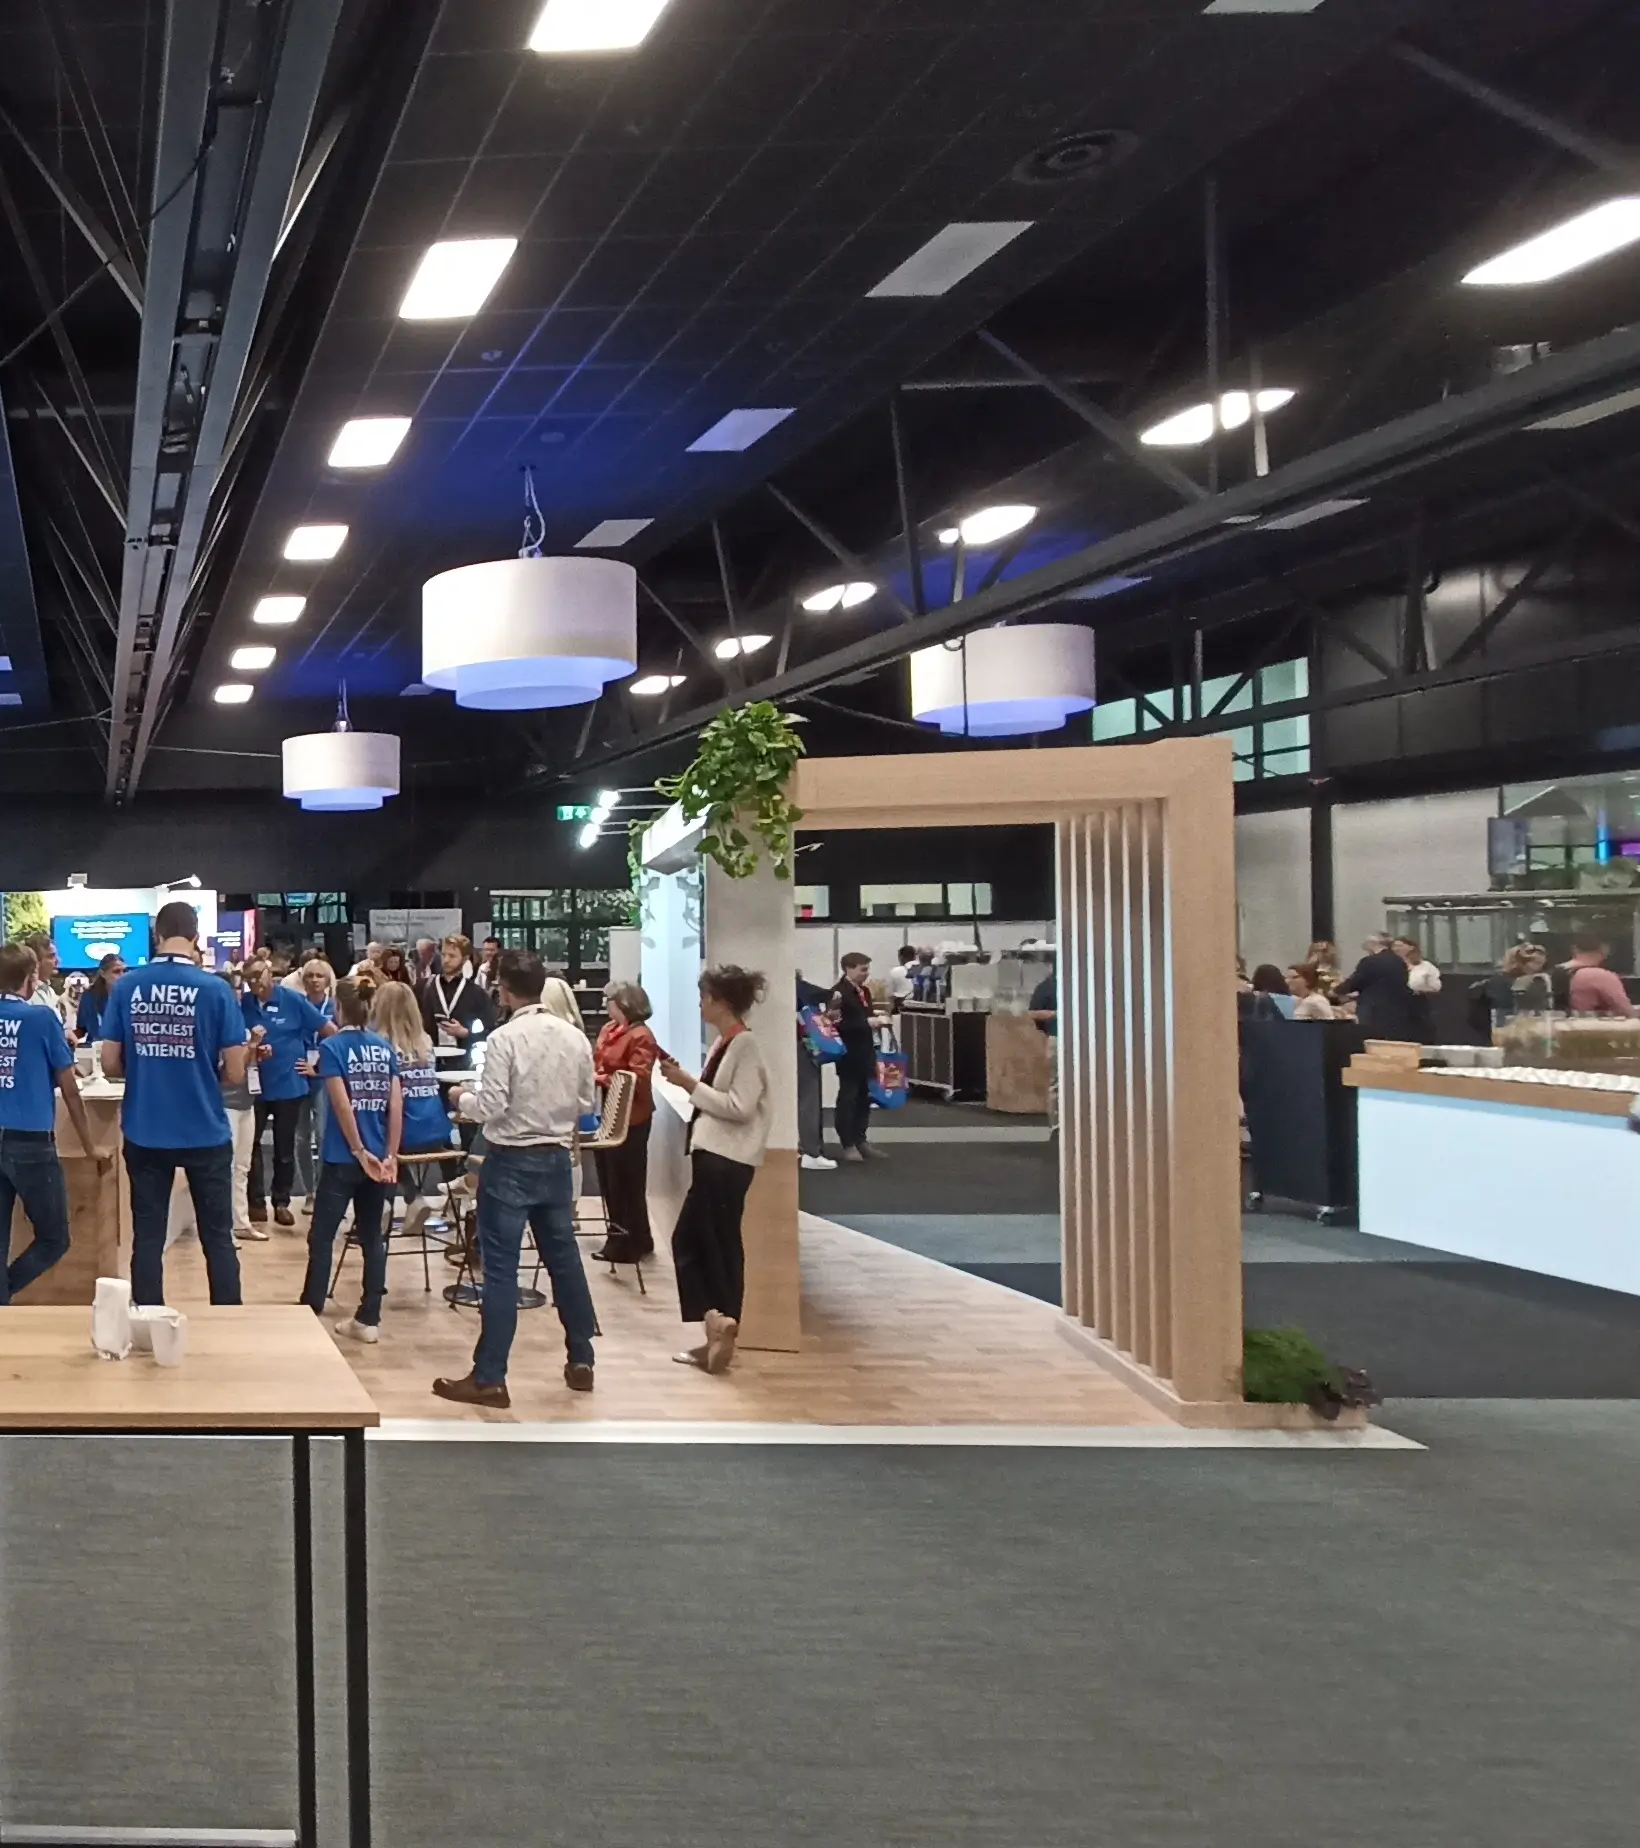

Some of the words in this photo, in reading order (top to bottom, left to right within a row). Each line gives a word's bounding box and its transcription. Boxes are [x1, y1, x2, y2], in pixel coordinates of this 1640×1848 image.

[130, 985, 143, 1003] A
[151, 984, 200, 1004] NEW
[129, 1002, 196, 1017] SOLUTION
[130, 1022, 196, 1037] TRICKIEST
[135, 1042, 196, 1059] PATIENTS
[347, 1047, 359, 1063] A
[360, 1044, 392, 1062] NEW
